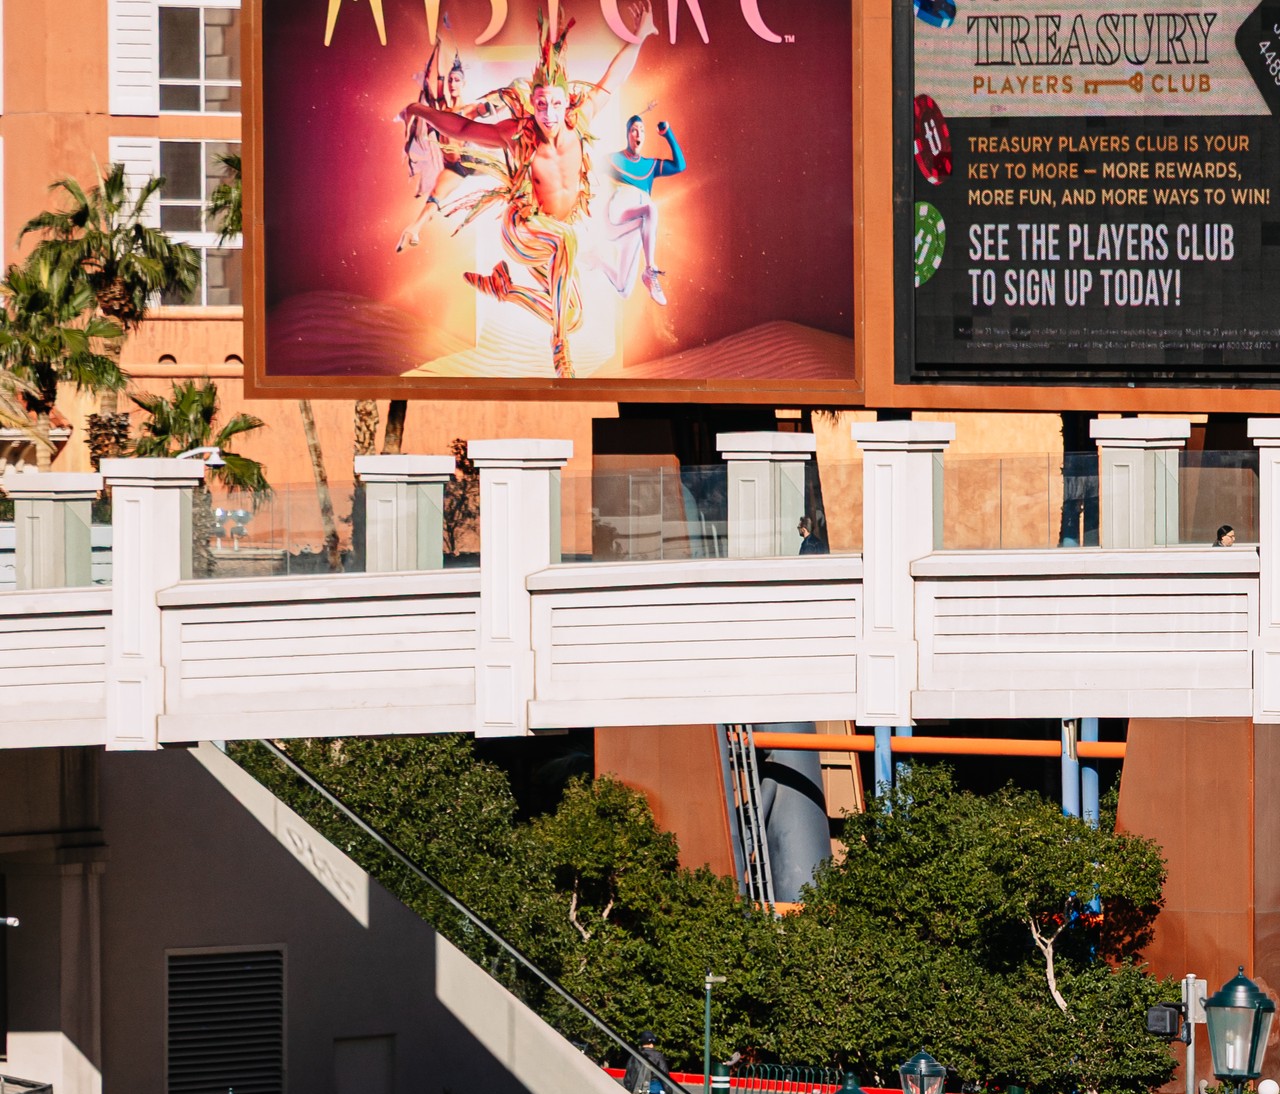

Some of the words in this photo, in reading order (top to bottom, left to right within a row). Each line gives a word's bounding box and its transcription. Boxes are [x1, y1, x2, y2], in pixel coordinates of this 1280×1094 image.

[967, 13, 1217, 66] TREASURY
[973, 75, 1073, 95] PLAYERS
[1151, 74, 1211, 93] CLUB
[968, 136, 1053, 153] TREASURY
[1059, 136, 1130, 152] PLAYERS
[1135, 135, 1178, 151] CLUB
[1184, 135, 1199, 151] IS
[1204, 135, 1250, 151] YOUR
[968, 163, 999, 179] KEY
[1004, 163, 1026, 179] TO
[1032, 163, 1079, 179] MORE
[1102, 162, 1149, 178] MORE
[1155, 162, 1242, 181] REWARDS,
[968, 189, 1014, 206] MORE
[1019, 189, 1056, 207] FUN,
[1061, 189, 1096, 205] AND
[1101, 189, 1148, 205] MORE
[1153, 188, 1199, 204] WAYS
[1204, 188, 1225, 204] TO
[1231, 188, 1270, 205] WIN!
[968, 224, 1010, 261] SEE
[1017, 224, 1060, 261] THE
[1068, 224, 1169, 261] PLAYERS
[1177, 223, 1235, 260] CLUB
[968, 269, 996, 306] TO
[1004, 269, 1056, 306] SIGN
[1065, 269, 1093, 306] UP
[1100, 269, 1181, 306] TODAY!
